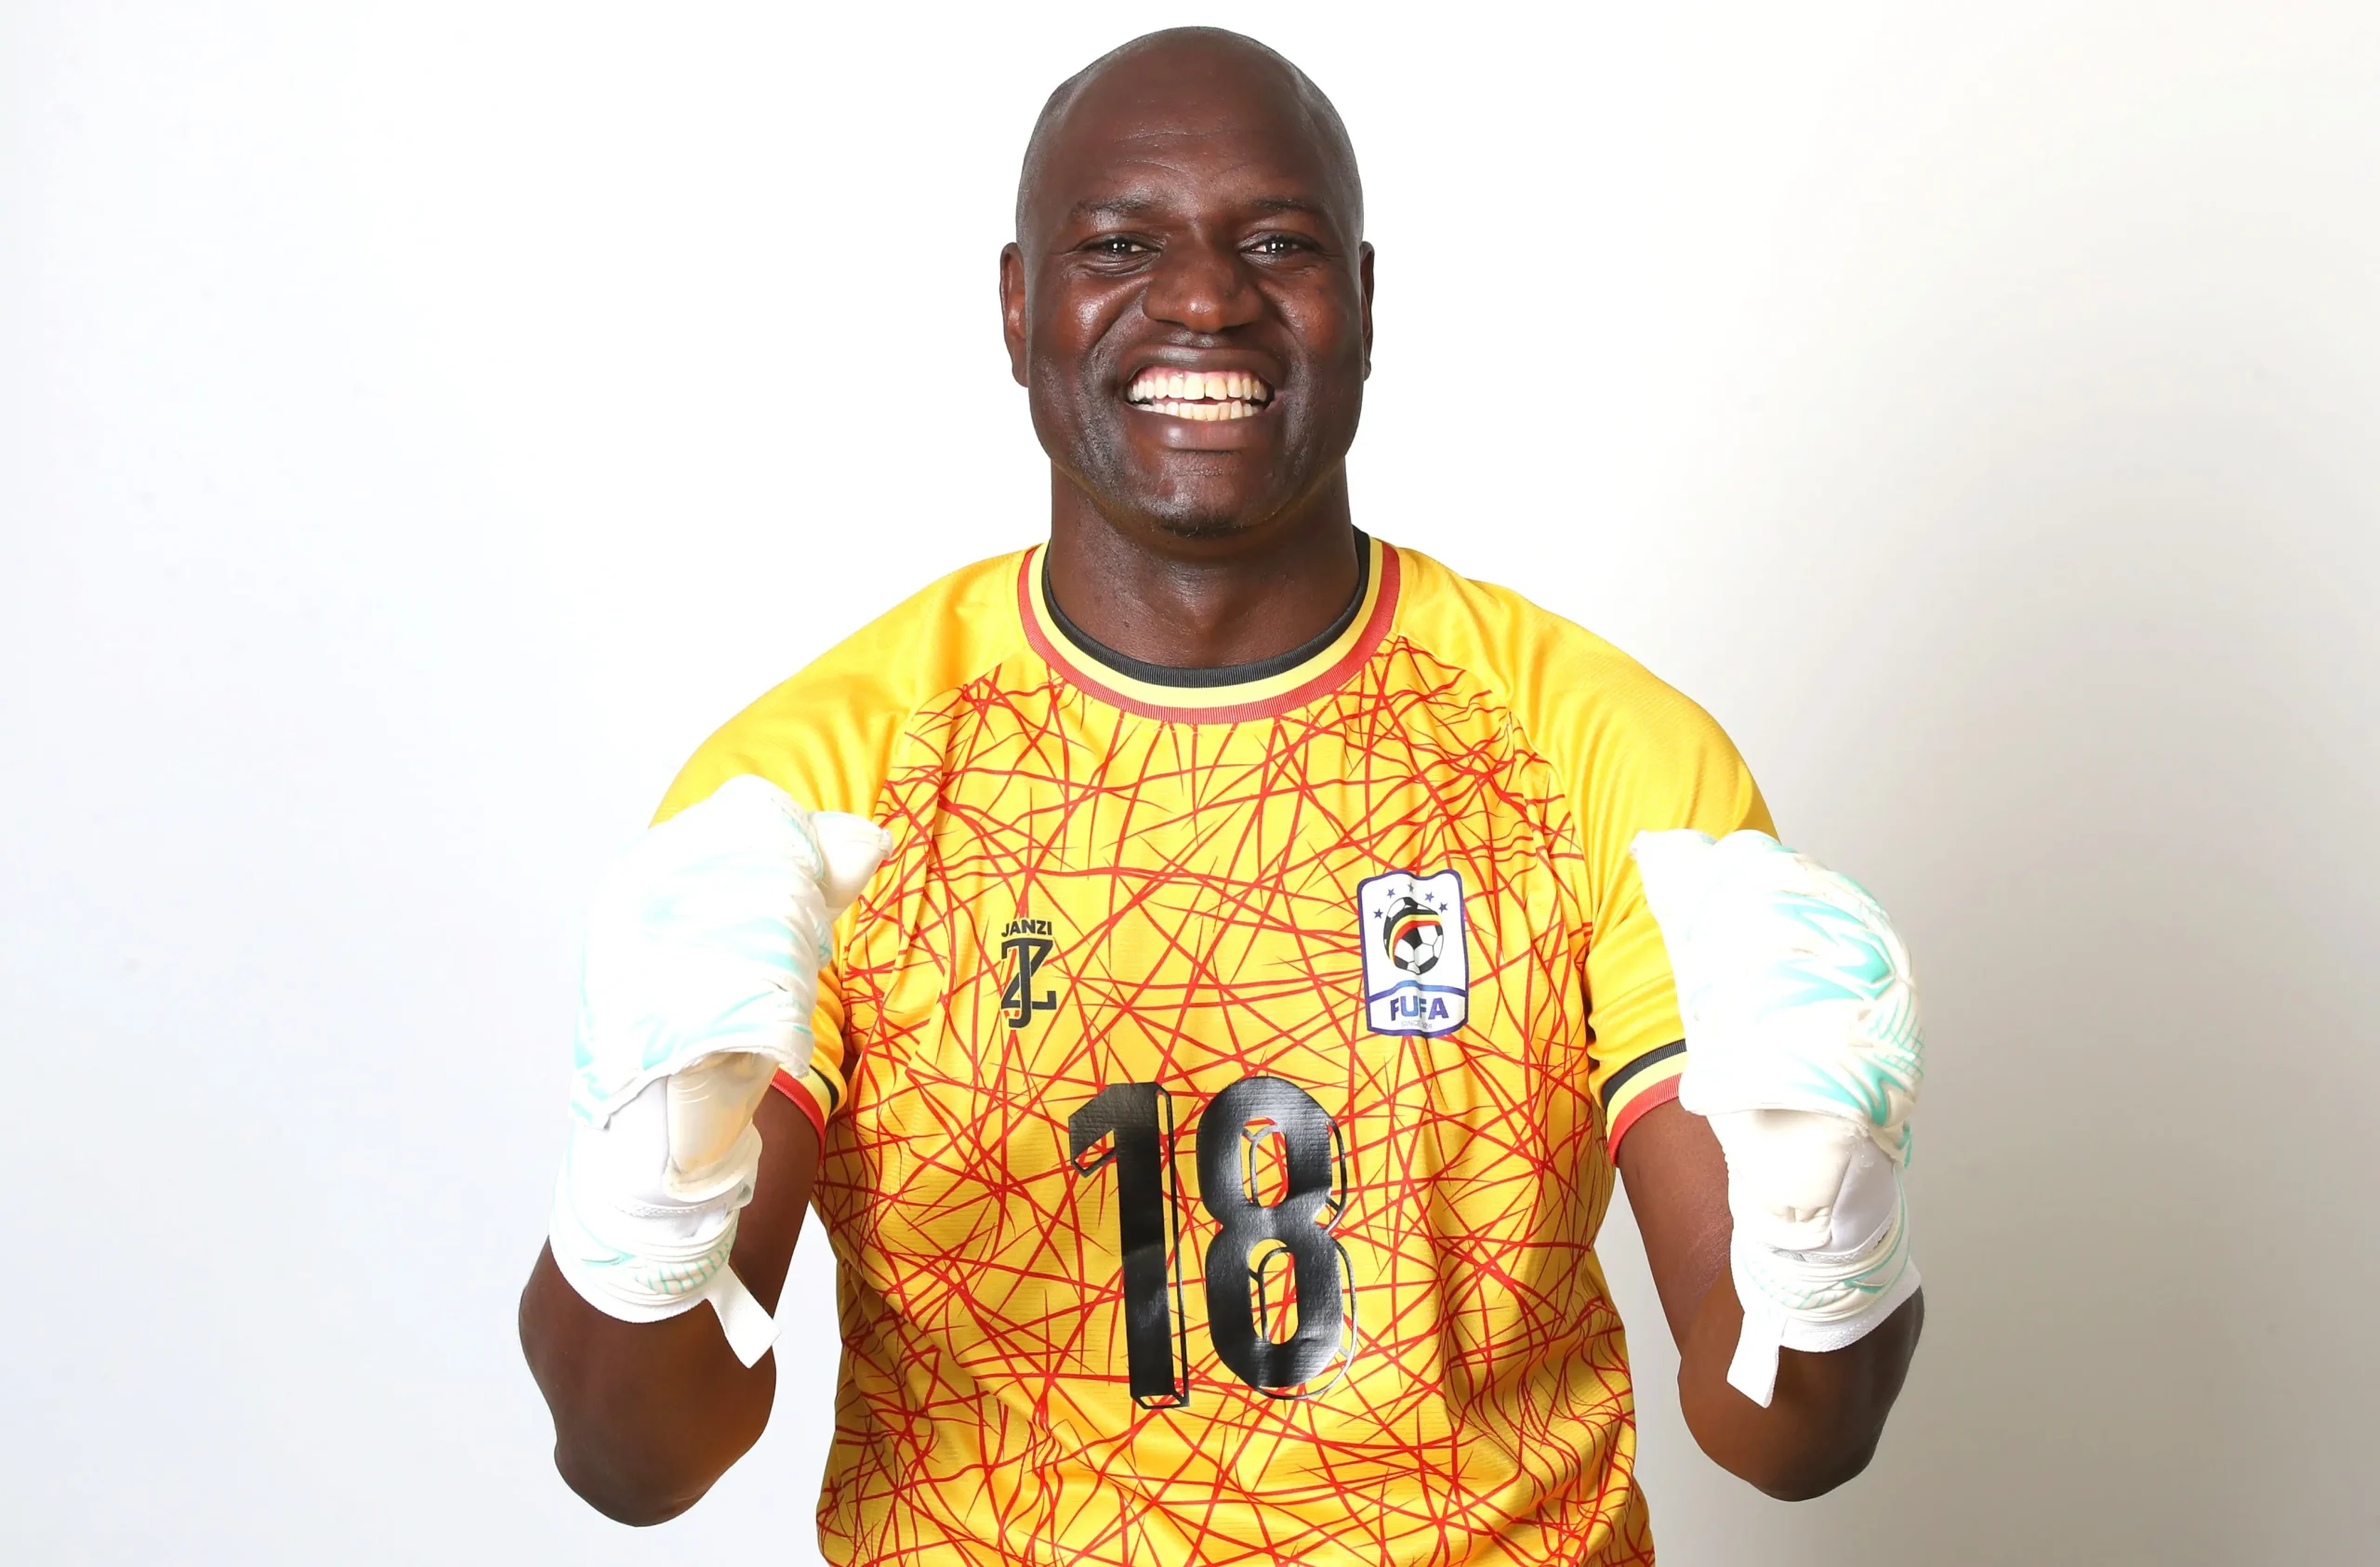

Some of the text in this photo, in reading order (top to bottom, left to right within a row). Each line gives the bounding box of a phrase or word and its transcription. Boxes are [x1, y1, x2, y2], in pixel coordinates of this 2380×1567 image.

[1001, 919, 1052, 937] JANZI
[1390, 994, 1449, 1021] FUFA
[1068, 1075, 1358, 1410] 18
